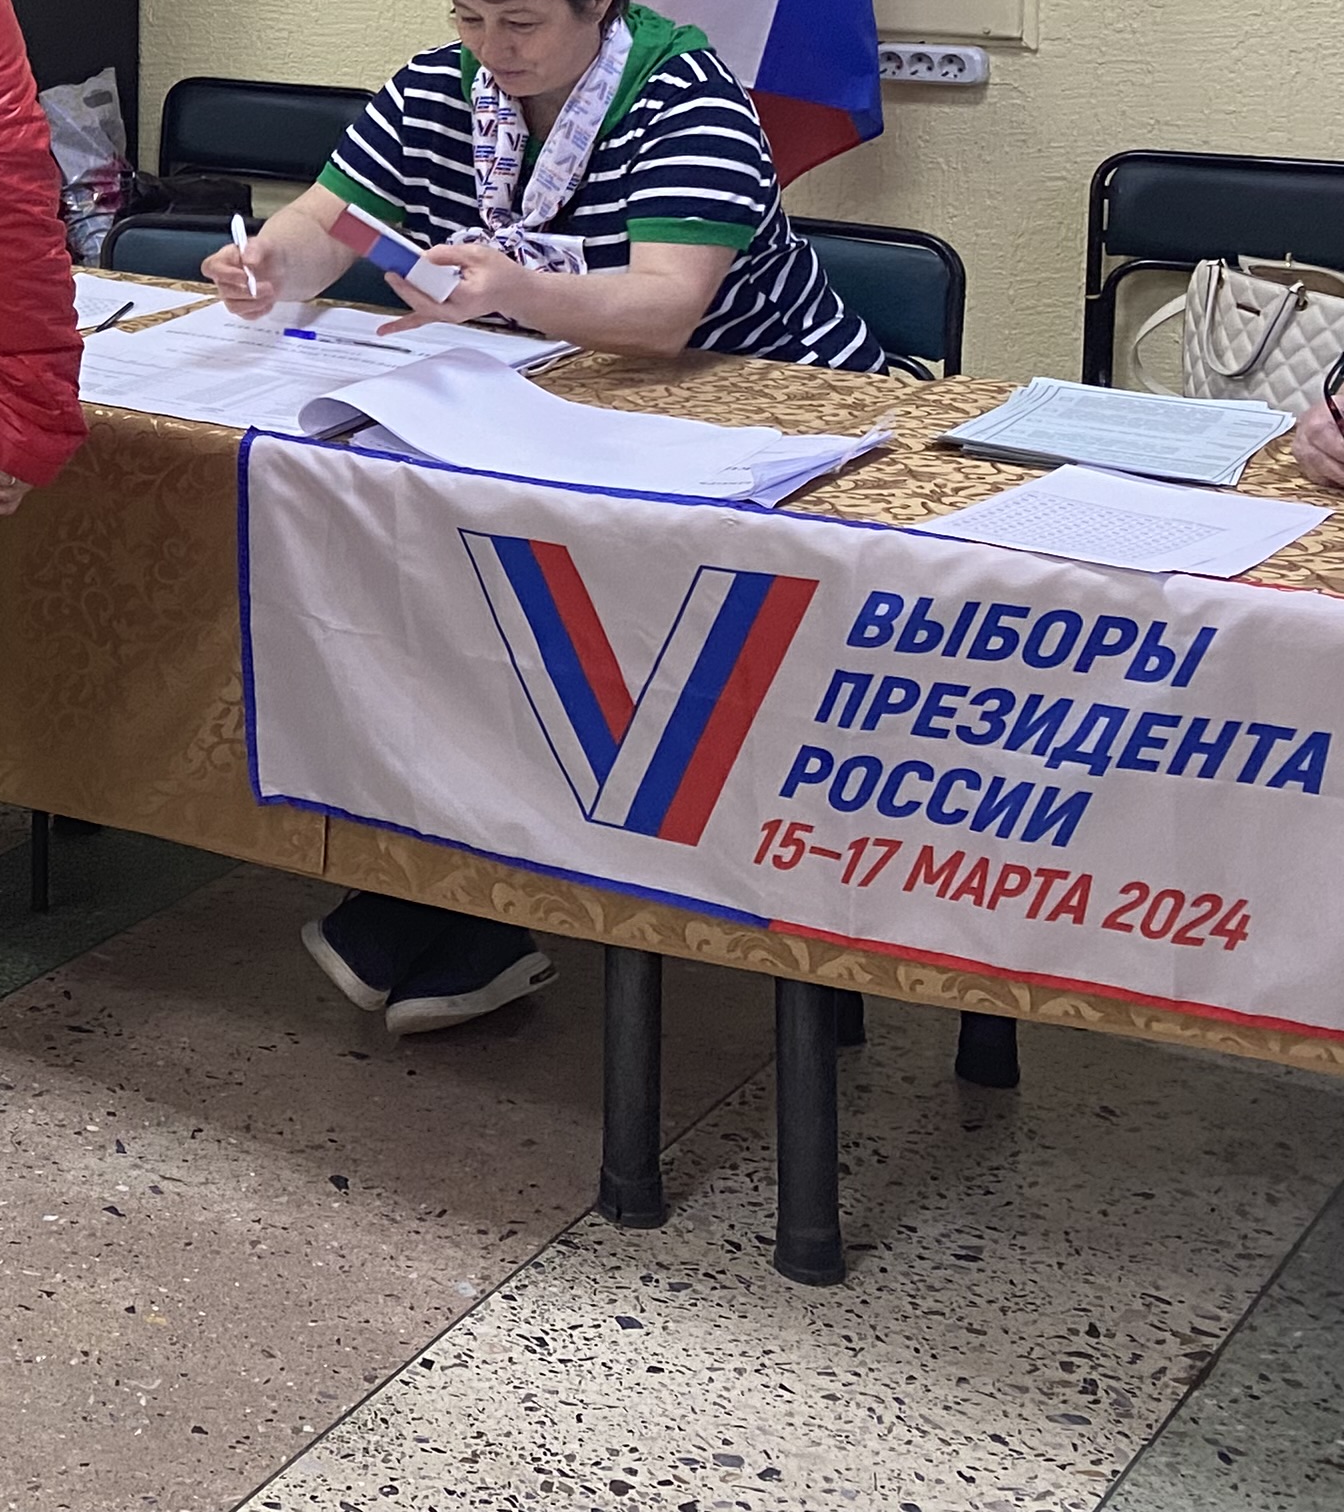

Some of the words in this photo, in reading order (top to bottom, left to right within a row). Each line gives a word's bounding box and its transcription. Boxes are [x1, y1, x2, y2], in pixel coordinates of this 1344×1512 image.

[846, 589, 1218, 689] ВЫБОРЫ
[814, 669, 1332, 795] ПРЕЗИДЕНТА
[779, 744, 1093, 848] РОССИИ
[902, 843, 1094, 926] МАРТА
[1100, 879, 1251, 953] 2024
